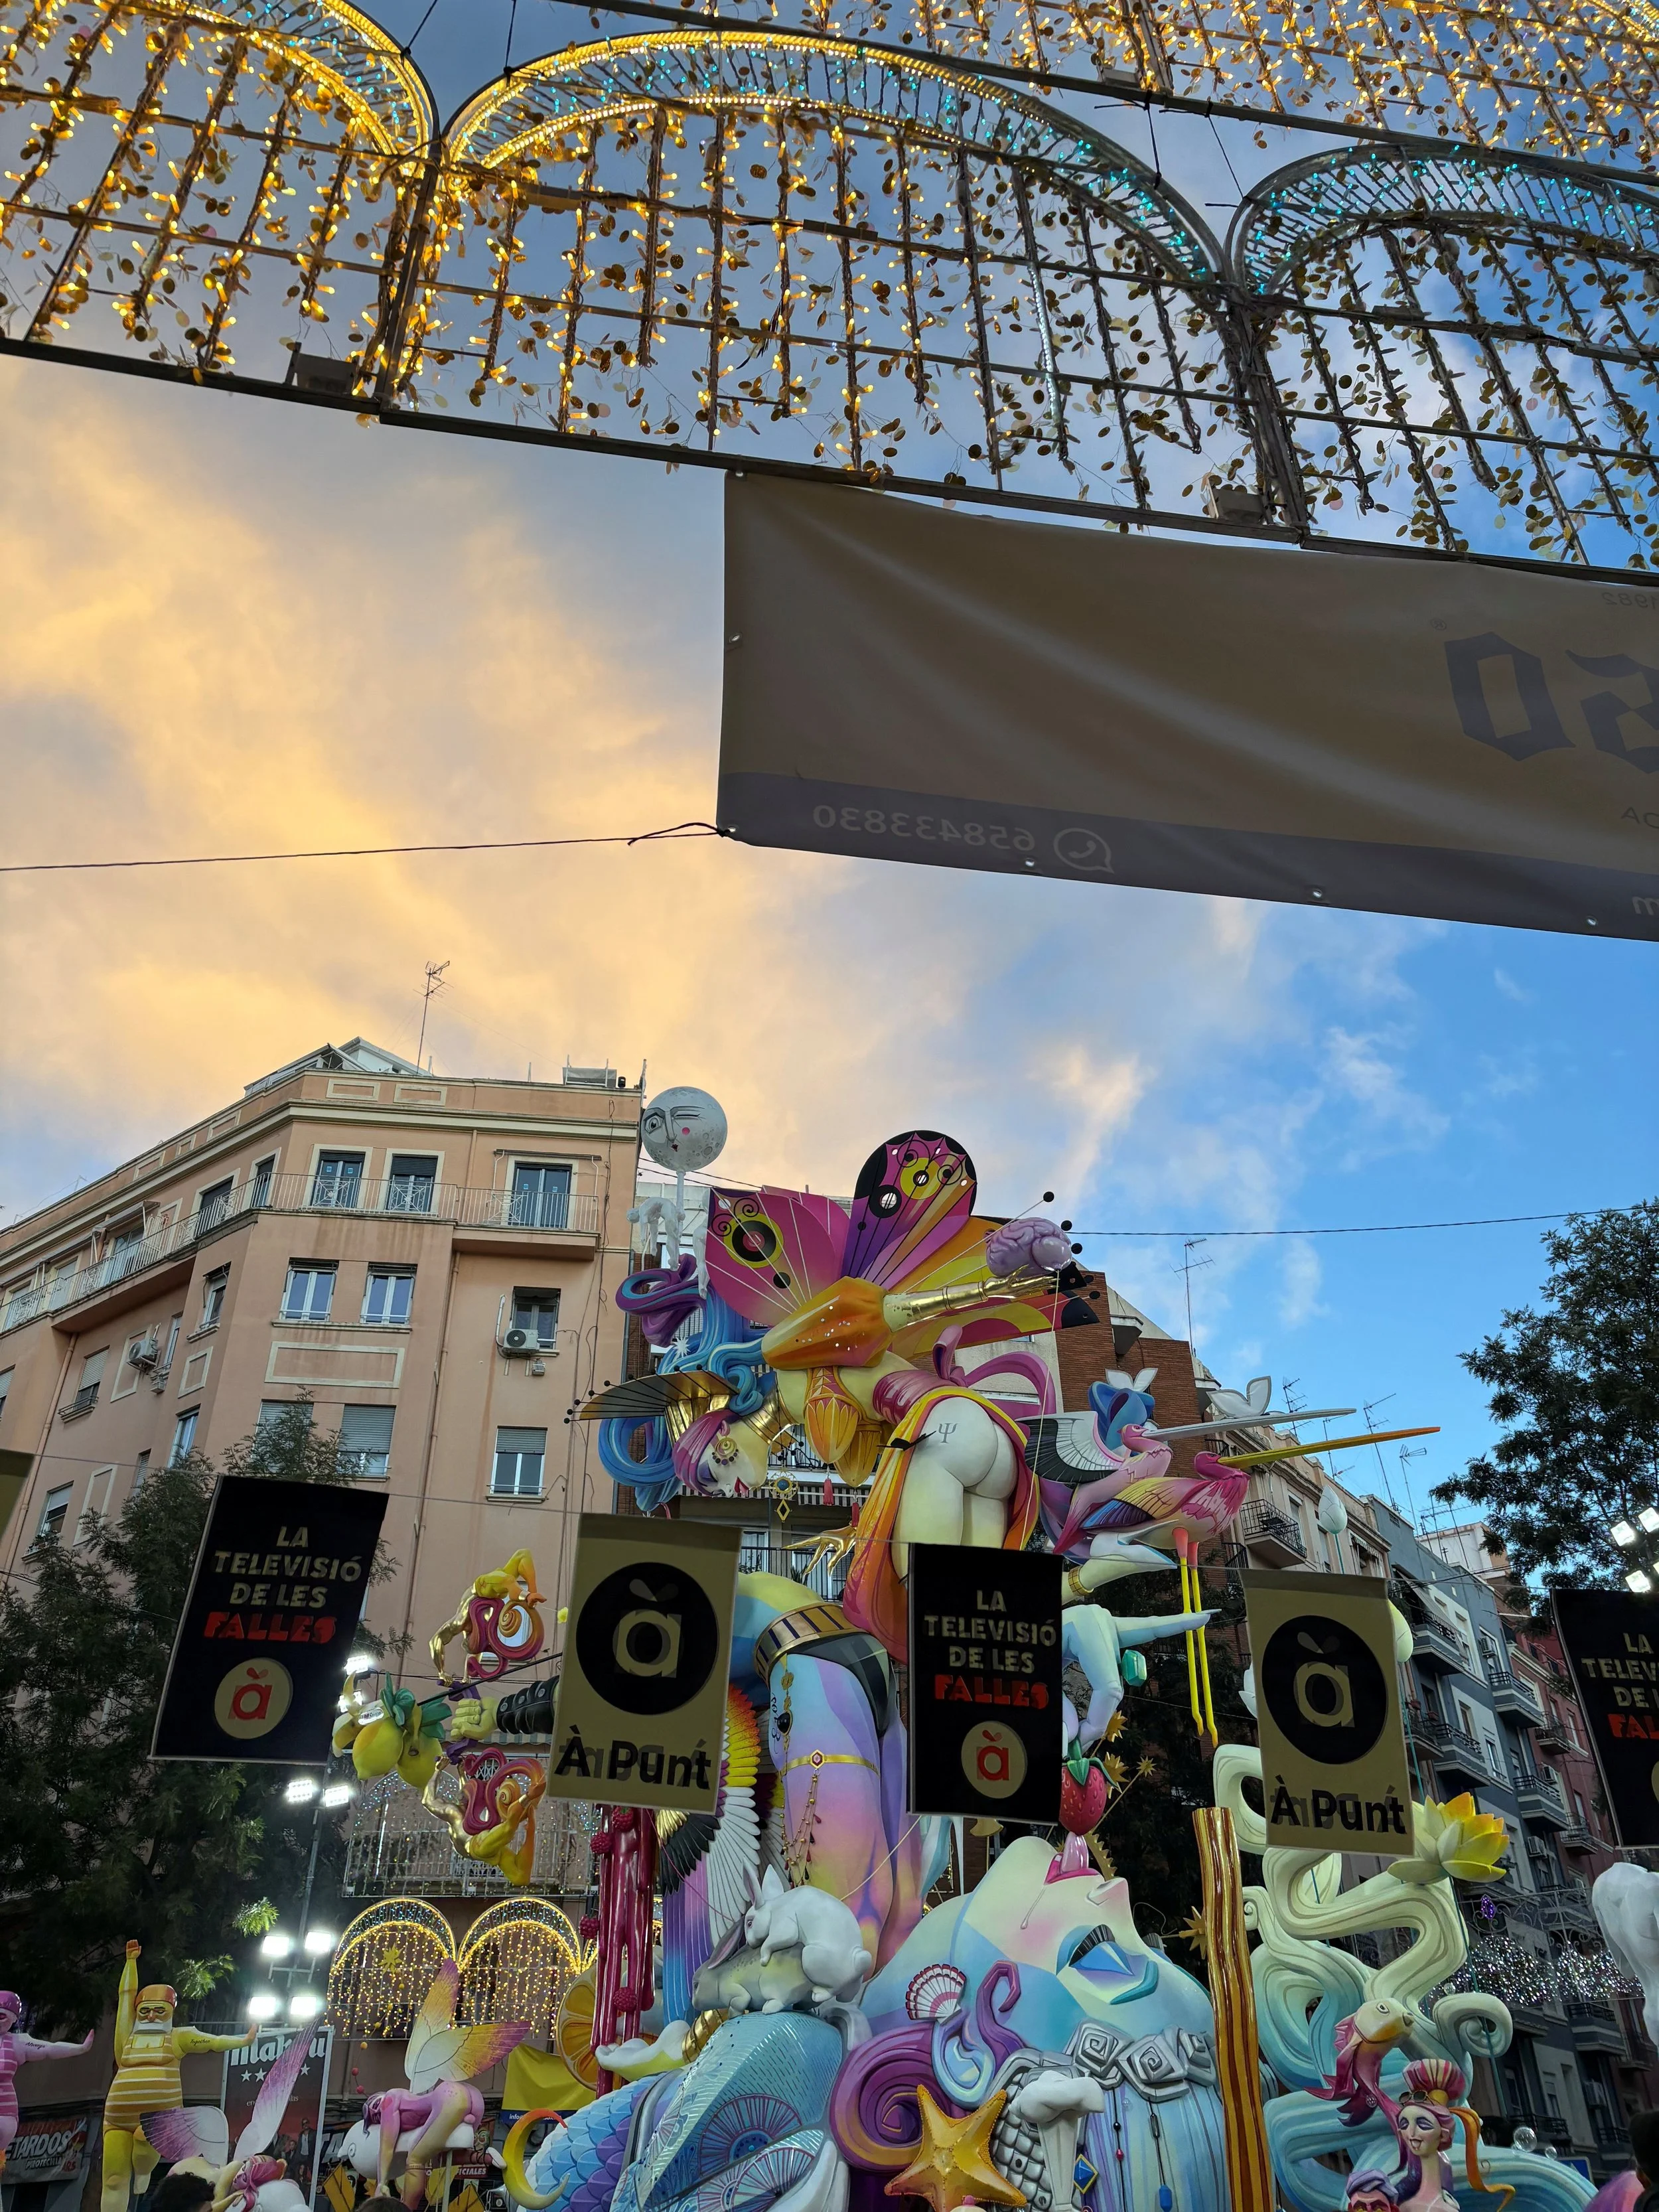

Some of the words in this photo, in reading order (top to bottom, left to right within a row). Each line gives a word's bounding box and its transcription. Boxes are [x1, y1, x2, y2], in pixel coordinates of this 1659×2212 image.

[276, 1526, 309, 1548] LA
[215, 1550, 363, 1582] TELEVISIÓ
[230, 1582, 271, 1605] DE
[276, 1584, 328, 1608] LES
[977, 1590, 1007, 1611] LA
[204, 1611, 337, 1644] FALLES
[924, 1615, 1056, 1647] TELEVISIÓ
[1623, 1633, 1654, 1654] LA
[949, 1645, 983, 1669] DE
[992, 1649, 1035, 1674] LES
[1581, 1658, 1659, 1681] TELEV
[934, 1674, 1048, 1710] FALLES
[1613, 1686, 1649, 1708] DE
[554, 1724, 591, 1777] À
[607, 1739, 711, 1790] Punt
[1270, 1774, 1301, 1826] À
[1312, 1789, 1407, 1834] Punt
